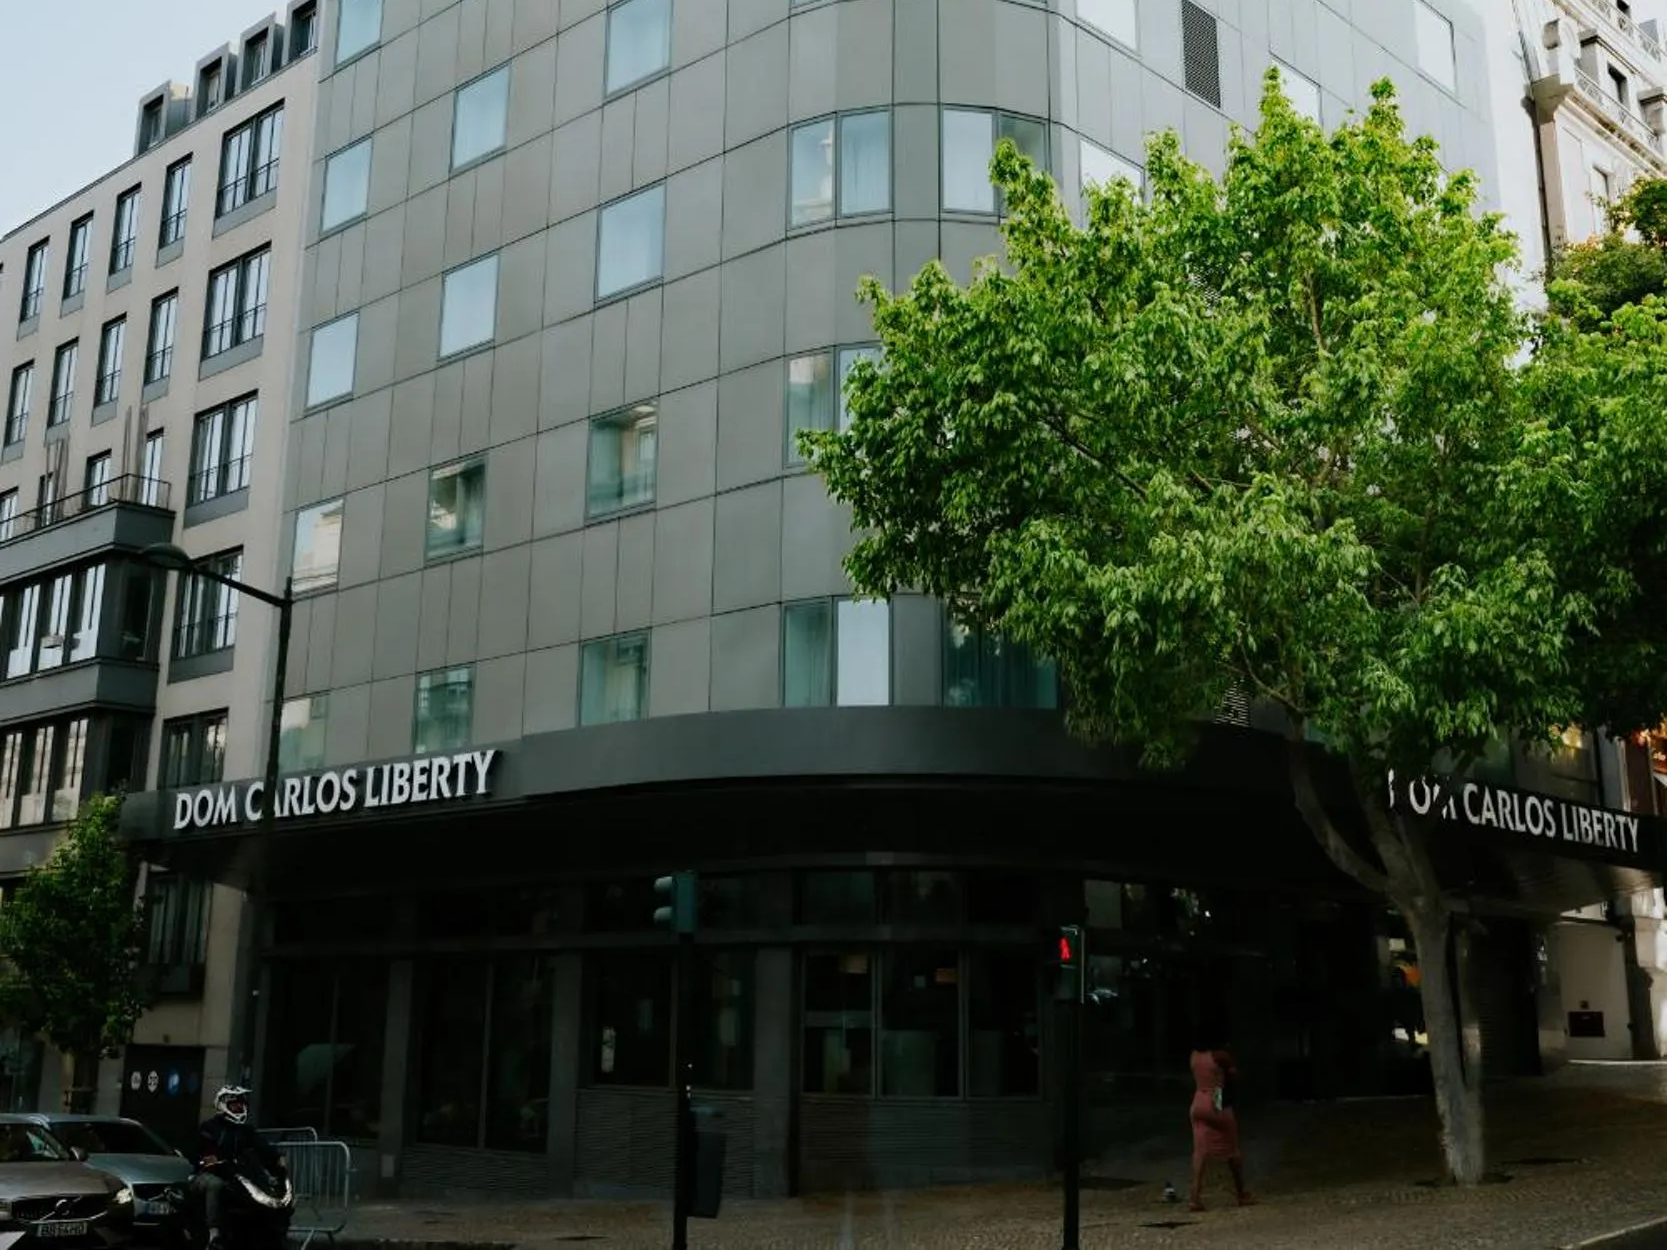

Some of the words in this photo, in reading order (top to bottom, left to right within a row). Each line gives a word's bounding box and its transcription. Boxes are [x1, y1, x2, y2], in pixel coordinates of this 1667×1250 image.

[173, 785, 238, 830] DOM
[364, 749, 498, 808] LIBERTY
[1462, 782, 1557, 839] CARLOS
[1559, 802, 1640, 854] LIBERTY
